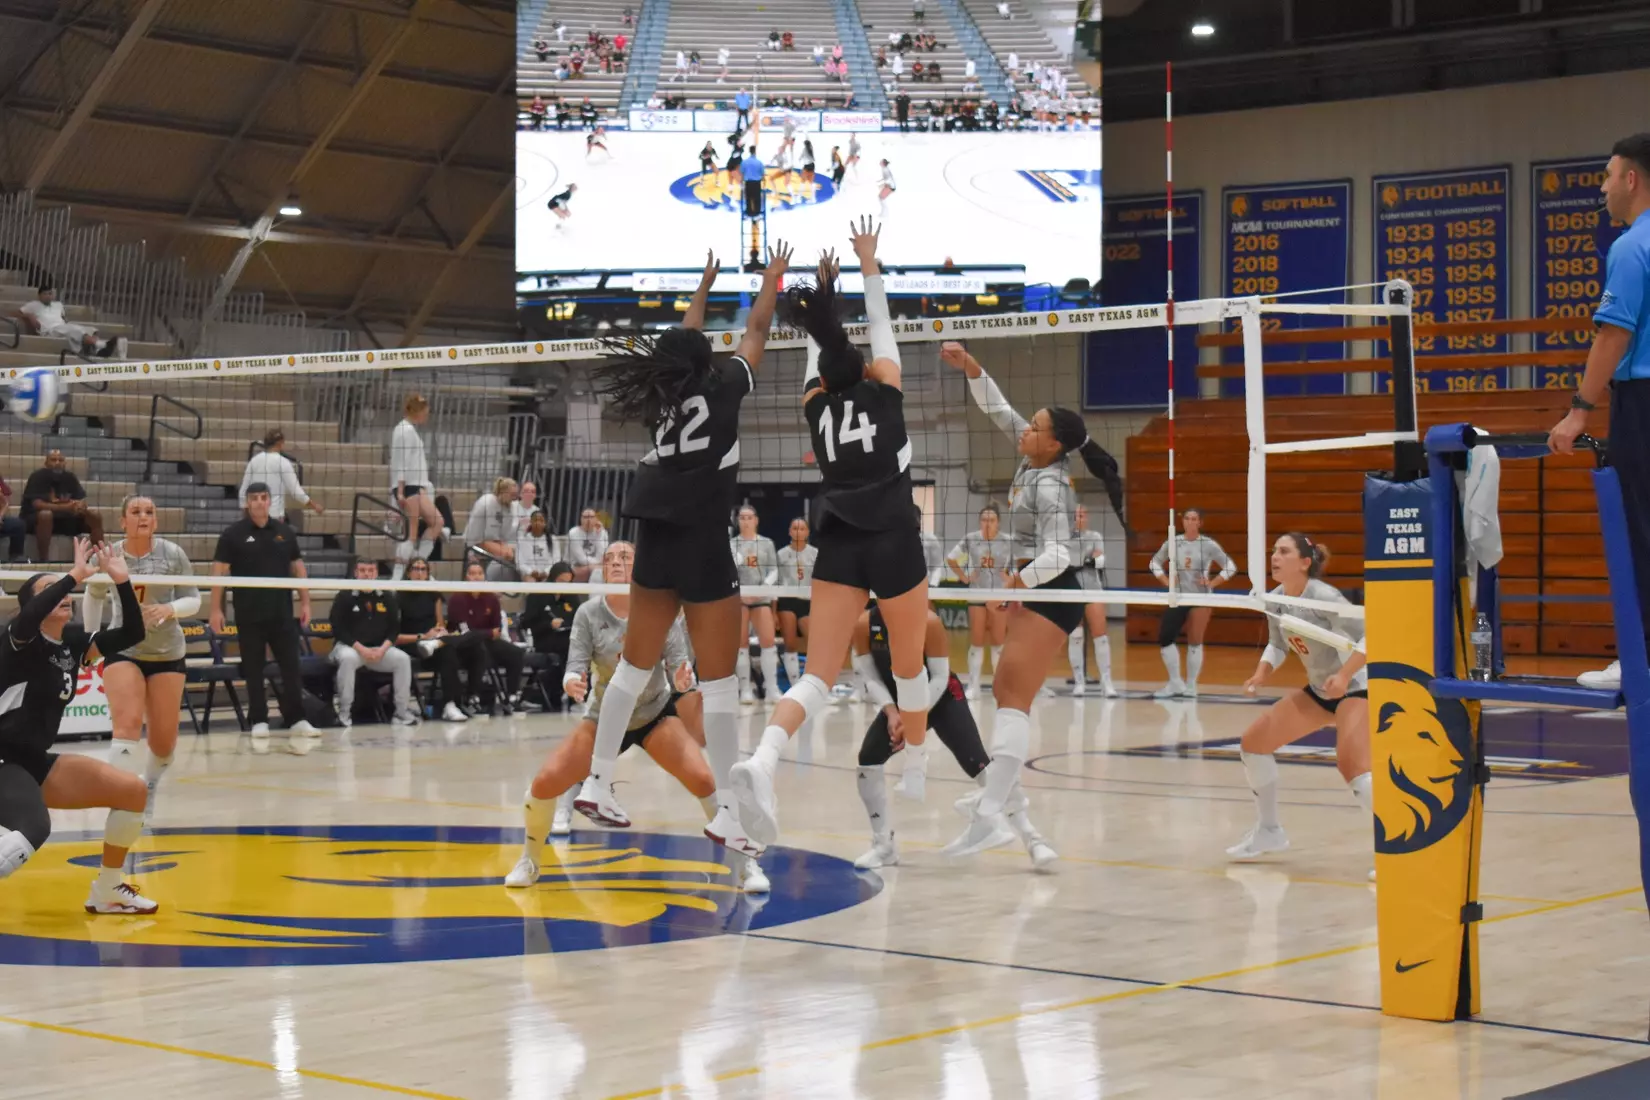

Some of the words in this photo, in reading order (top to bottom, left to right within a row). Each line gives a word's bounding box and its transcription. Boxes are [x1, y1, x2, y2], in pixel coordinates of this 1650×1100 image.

[1404, 180, 1504, 201] FOOTBALL
[1261, 196, 1337, 211] SOFTBALL
[1231, 220, 1263, 233] NCAA
[1264, 217, 1341, 230] TOURNAMENT
[1545, 211, 1599, 232] 1969
[1385, 223, 1435, 243] 1933
[1445, 218, 1496, 239] 1952
[1233, 233, 1279, 252] 2016
[1545, 234, 1596, 255] 1972
[1385, 245, 1435, 265] 1934
[1445, 240, 1496, 261] 1953
[1232, 255, 1279, 273] 2018
[1545, 257, 1599, 277] 1983
[1445, 263, 1496, 283] 1954
[1232, 276, 1279, 294] 2019
[1545, 280, 1600, 301] 1990
[1445, 285, 1496, 305] 1955
[952, 320, 977, 330] EAST
[981, 318, 1013, 328] TEXAS
[1016, 316, 1037, 326] A&M
[1068, 314, 1095, 324] EAST
[1099, 311, 1132, 322] TEXAS
[1136, 308, 1159, 319] A&M
[1445, 308, 1495, 324] 1957
[903, 324, 923, 333] A&M
[463, 349, 482, 357] EAST
[485, 347, 509, 356] TEXAS
[551, 344, 570, 352] EAST
[573, 342, 599, 351] TEXAS
[245, 359, 266, 368] TEXAS
[321, 355, 343, 363] TEXAS
[380, 353, 398, 361] EAST
[401, 352, 424, 361] TEXAS
[173, 363, 193, 371] TEXAS
[655, 395, 711, 457] 22
[818, 400, 876, 462] 14
[1389, 508, 1420, 519] EAST
[1386, 523, 1423, 534] TEXAS
[1383, 537, 1425, 554] A&M
[59, 672, 73, 700] 3
